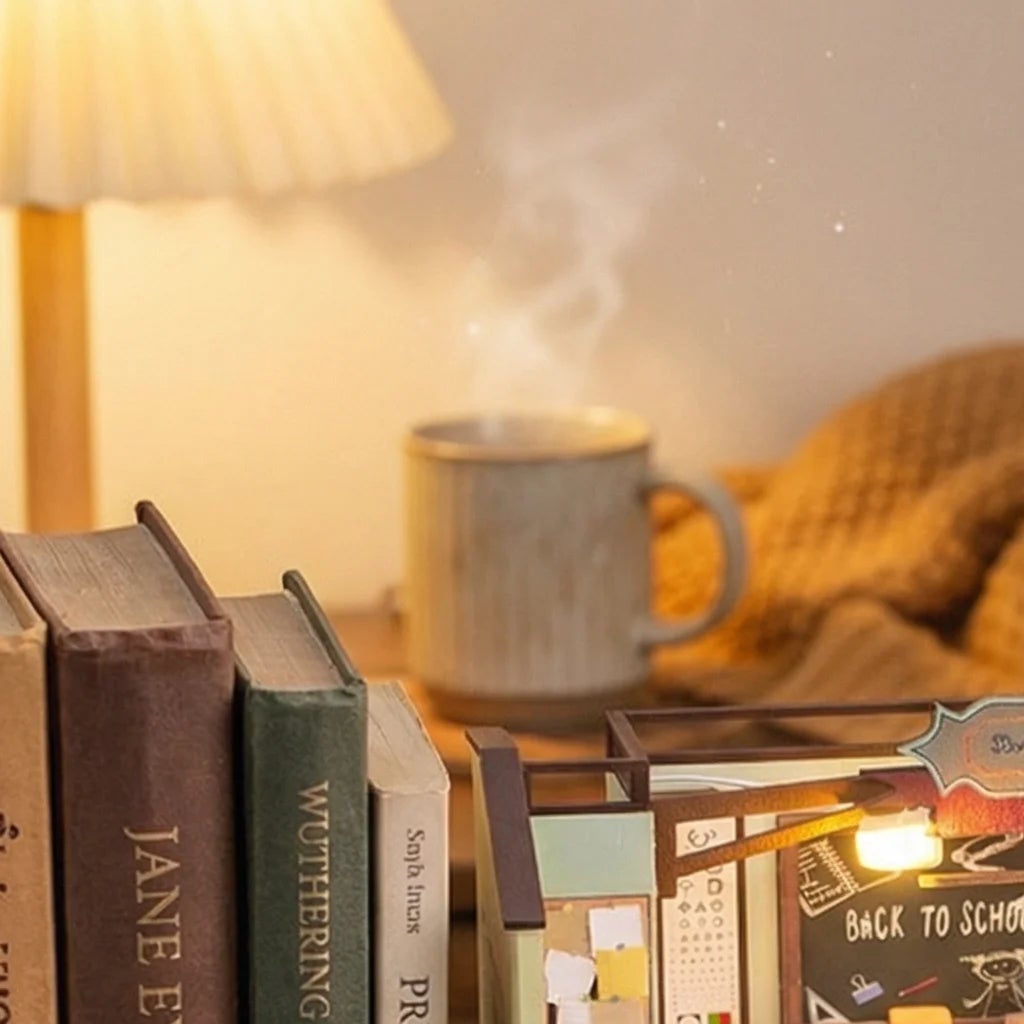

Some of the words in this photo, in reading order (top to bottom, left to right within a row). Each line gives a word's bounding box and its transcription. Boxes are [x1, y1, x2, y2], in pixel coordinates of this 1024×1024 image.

[124, 826, 181, 966] JANE
[298, 780, 331, 1020] WUTHERING
[845, 904, 905, 942] BACK
[920, 904, 950, 938] TO
